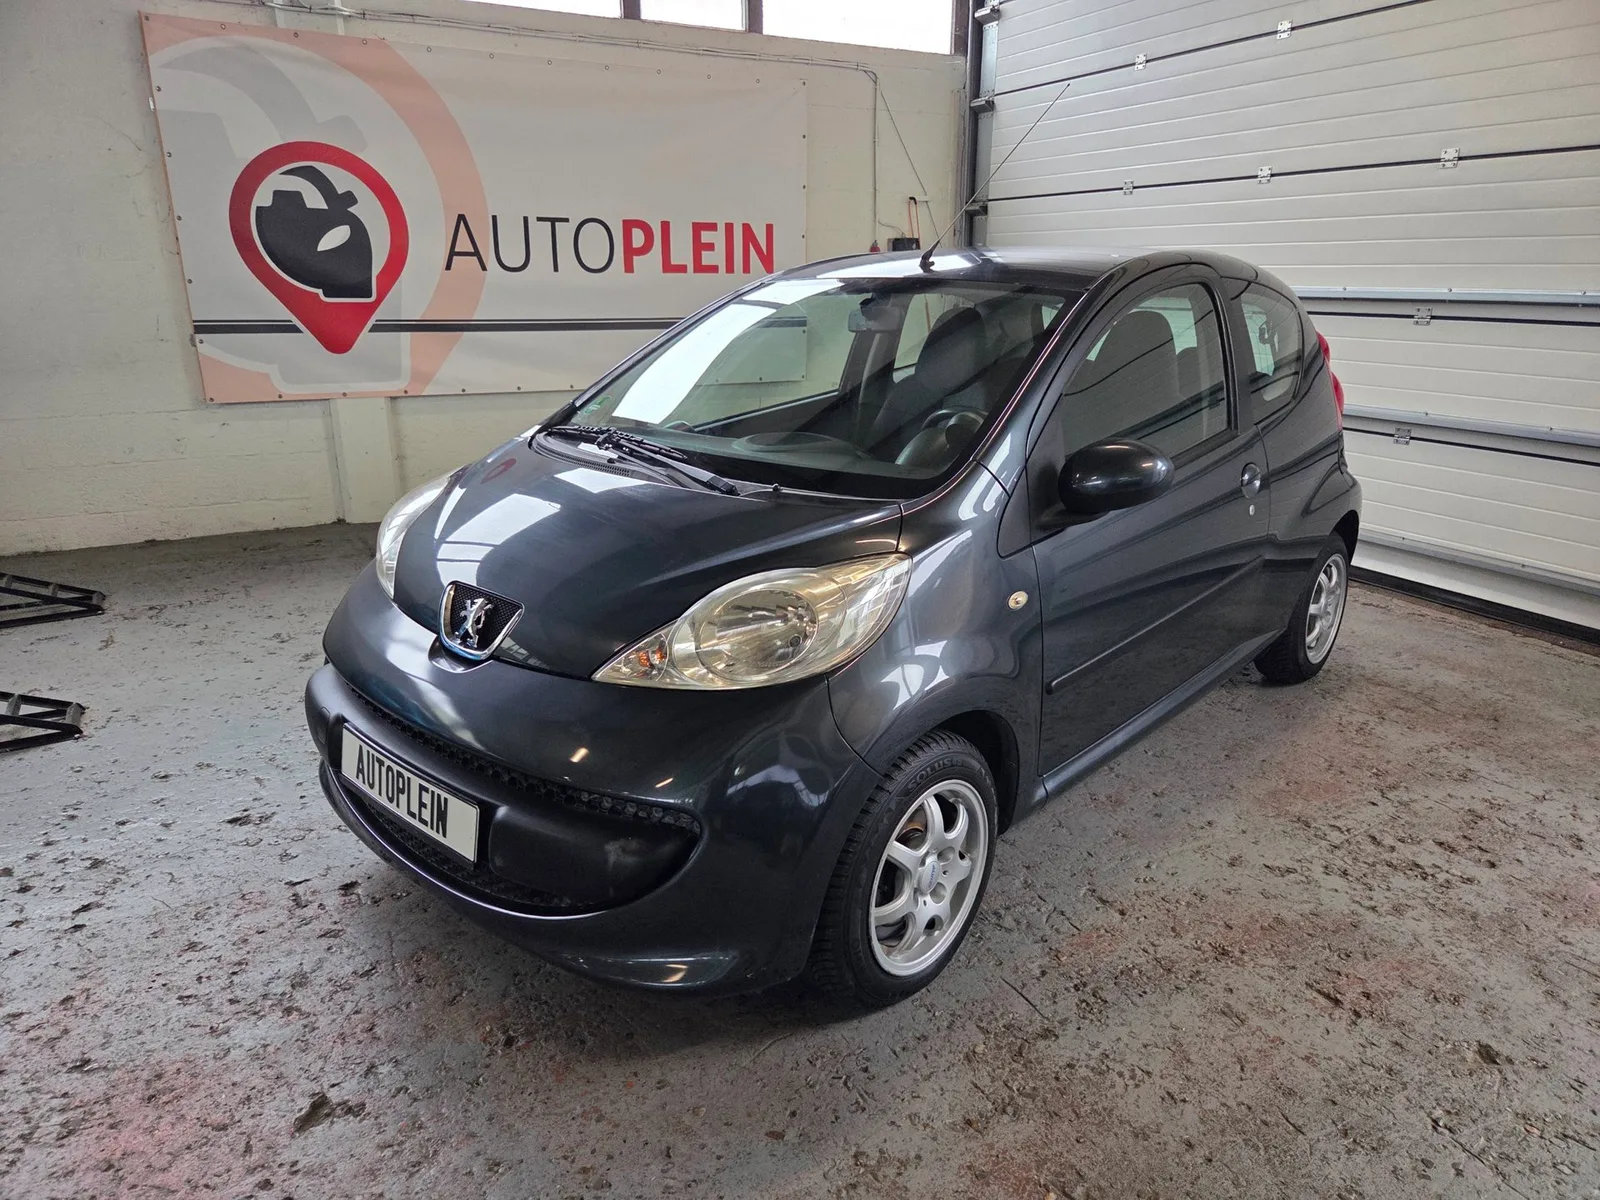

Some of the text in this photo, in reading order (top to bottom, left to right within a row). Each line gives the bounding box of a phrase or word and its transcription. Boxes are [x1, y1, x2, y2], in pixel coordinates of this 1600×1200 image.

[444, 213, 774, 274] AUTOPLEIN
[355, 744, 449, 839] AUTOPLEIN
[908, 758, 952, 792] SOLUS
